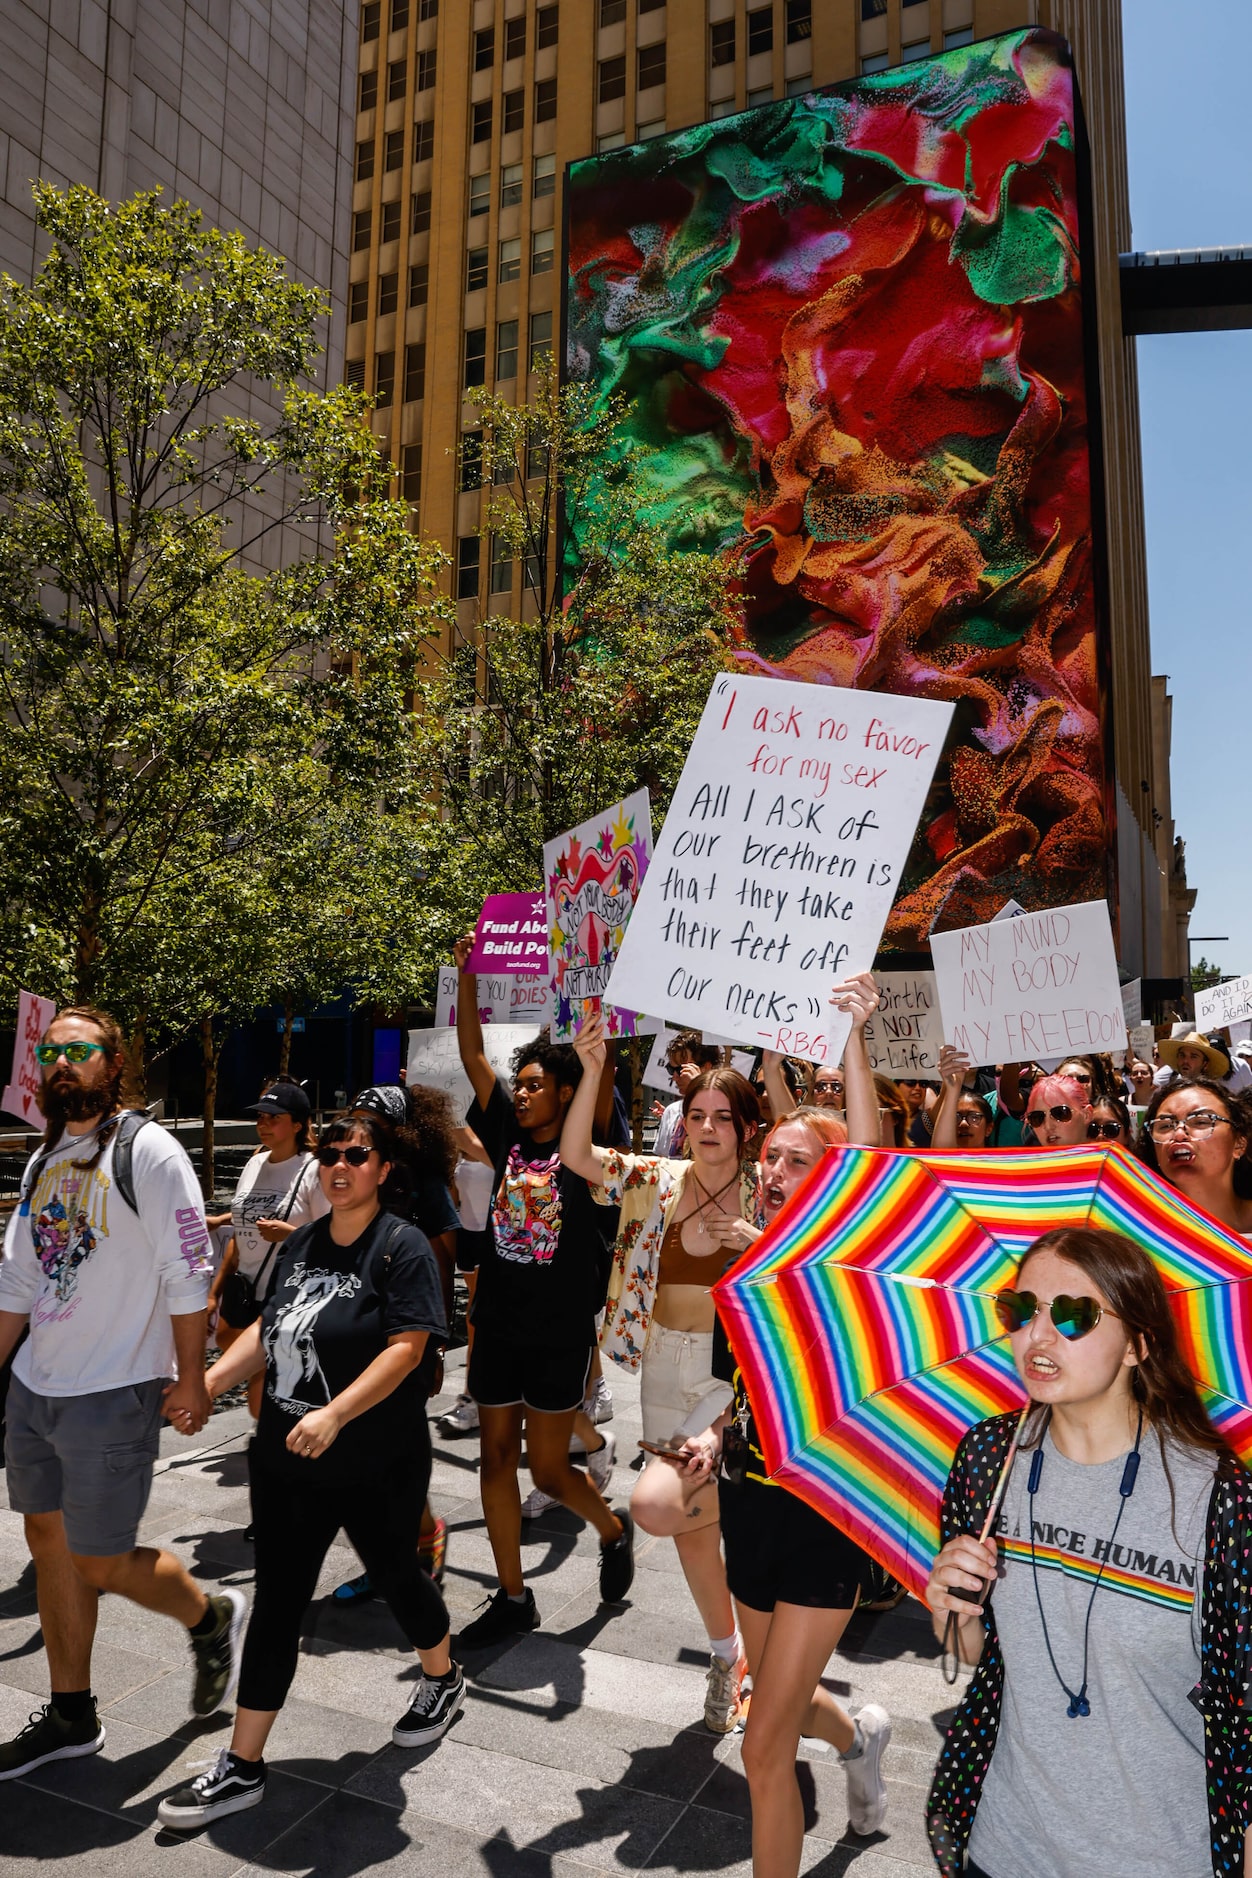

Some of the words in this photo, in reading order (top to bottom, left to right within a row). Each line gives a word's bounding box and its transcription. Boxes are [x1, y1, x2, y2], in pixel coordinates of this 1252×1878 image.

[753, 706, 804, 739] ask
[818, 717, 848, 743] no
[863, 718, 932, 760] favor
[746, 743, 792, 777] for
[800, 757, 832, 798] my
[840, 763, 888, 789] sex
[689, 783, 731, 821] All
[743, 788, 755, 822] I
[766, 796, 826, 834] ASK
[838, 810, 880, 841] of
[743, 835, 857, 878] brethren
[867, 859, 892, 887] is
[660, 867, 717, 903] that
[735, 878, 789, 922] they
[797, 886, 854, 922] take
[481, 920, 520, 934] Fund
[482, 941, 524, 955] Build
[661, 907, 721, 951] their
[731, 920, 791, 964] feet
[800, 940, 849, 973] off
[960, 928, 990, 968] MY
[1012, 913, 1071, 957] MIND
[487, 981, 507, 1001] YOU
[510, 986, 548, 1007] ODIES
[566, 968, 585, 996] NOT
[877, 981, 930, 1012] Birth
[963, 964, 995, 1012] MY
[1012, 952, 1081, 993] BODY
[1202, 1004, 1215, 1016] DO
[1221, 996, 1234, 1009] IT
[882, 1013, 927, 1038] NOT
[953, 1021, 991, 1064] MY
[1004, 1007, 1123, 1056] FREEDOM
[1013, 1520, 1021, 1537] A
[1031, 1520, 1087, 1555] NICE
[1091, 1537, 1197, 1588] HUMAN
